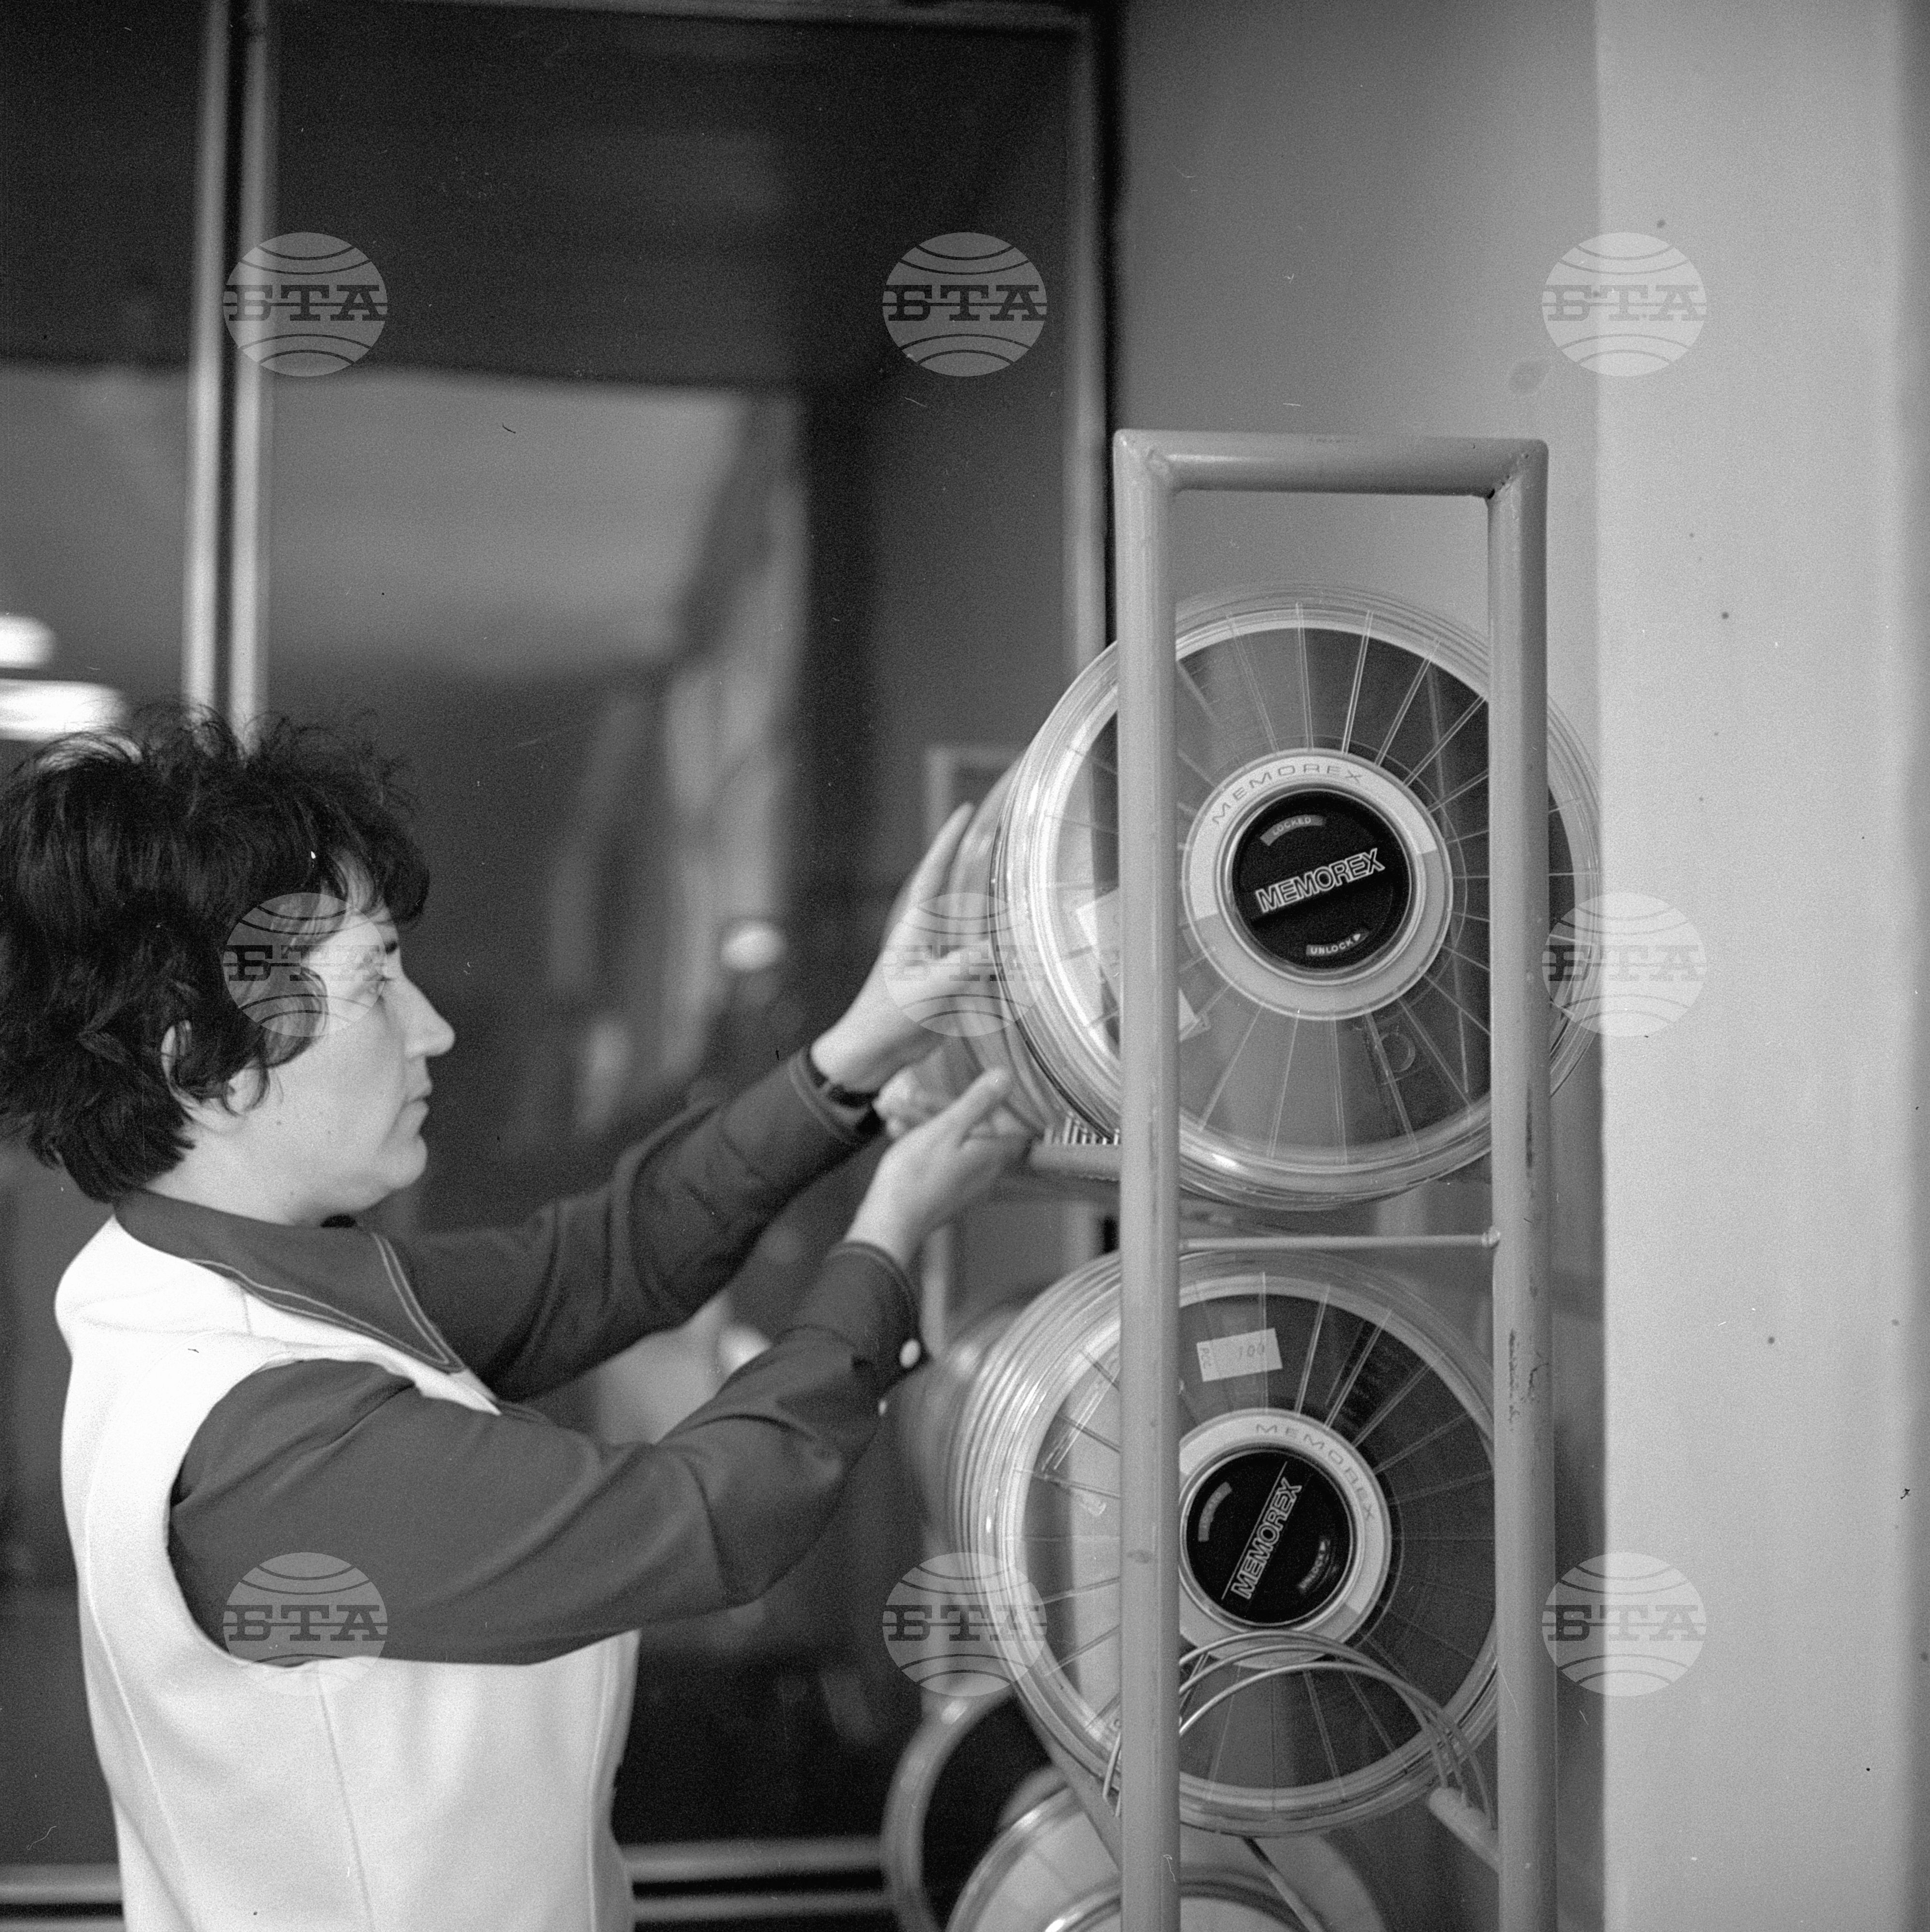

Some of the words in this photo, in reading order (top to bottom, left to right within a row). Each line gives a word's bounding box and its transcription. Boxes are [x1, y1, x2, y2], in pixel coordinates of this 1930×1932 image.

[1212, 764, 1362, 825] MEMOREX
[1255, 847, 1385, 913] MEMOREX
[1310, 938, 1354, 954] UNLOCK
[1256, 1424, 1375, 1521] MEMOREX
[1230, 1477, 1302, 1600] MEMOREX
